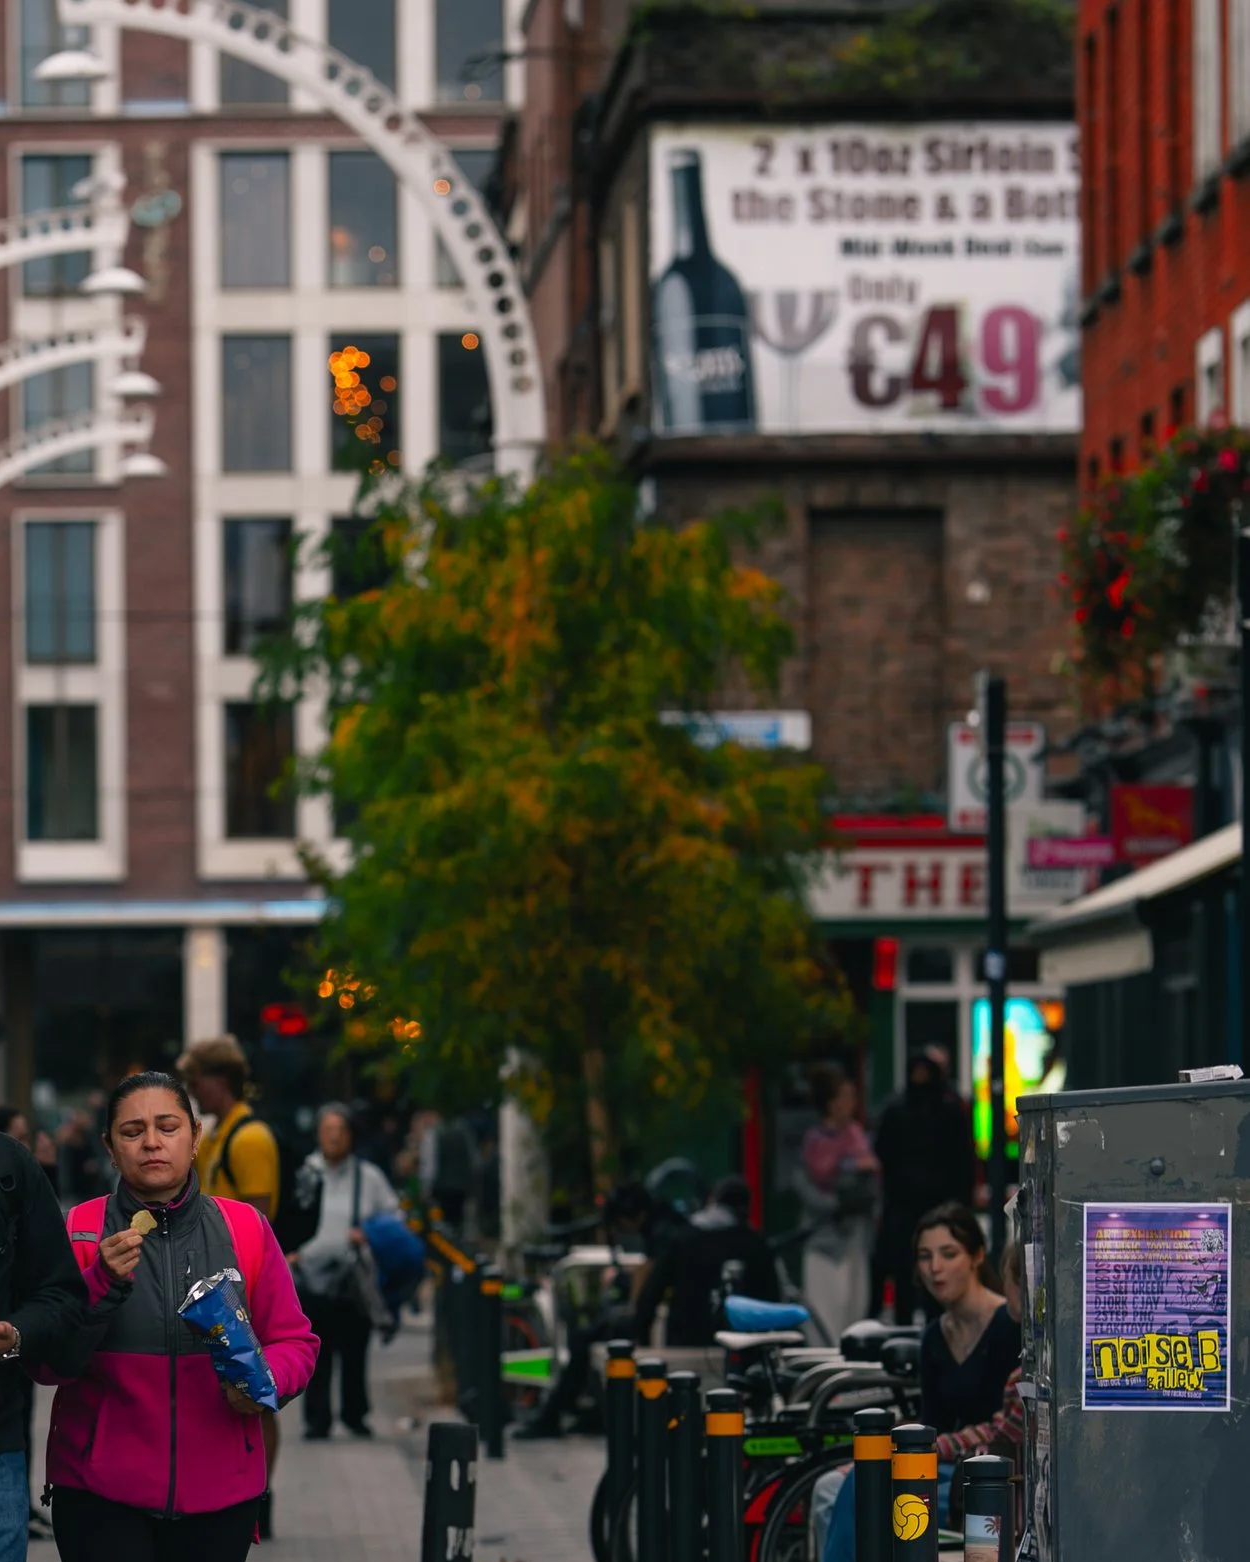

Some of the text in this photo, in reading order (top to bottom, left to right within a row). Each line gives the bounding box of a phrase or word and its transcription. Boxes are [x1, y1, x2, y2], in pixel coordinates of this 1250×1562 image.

[753, 140, 773, 174] 2
[731, 187, 795, 222] the
[807, 186, 922, 222] Stone
[1095, 1229, 1120, 1240] ART
[1132, 1281, 1164, 1295] GREEN
[1093, 1337, 1188, 1377] noise
[1147, 1367, 1204, 1390] gallery
